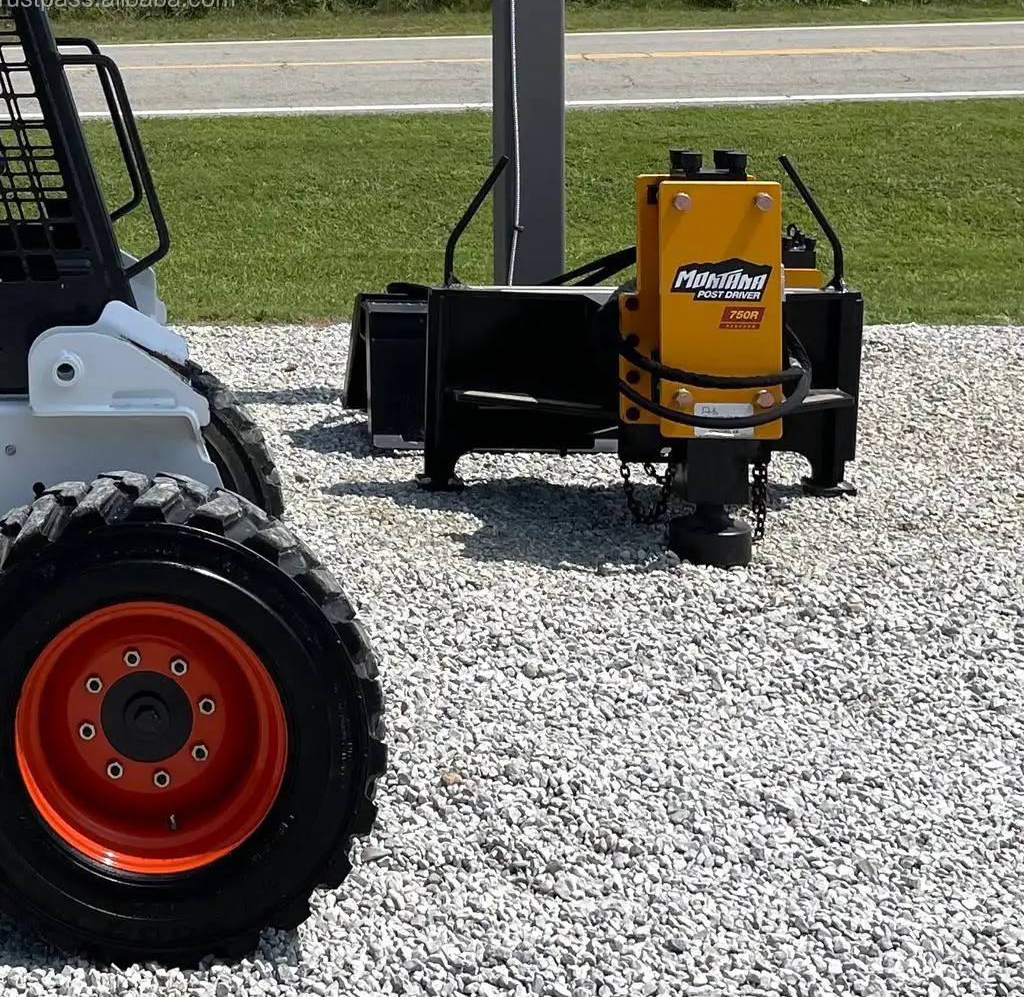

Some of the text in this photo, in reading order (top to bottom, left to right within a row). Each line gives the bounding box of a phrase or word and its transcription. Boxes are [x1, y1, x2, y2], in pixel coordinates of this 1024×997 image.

[674, 268, 768, 291] MONTANA
[697, 290, 761, 300] POST DRIVER
[729, 310, 759, 320] 750R
